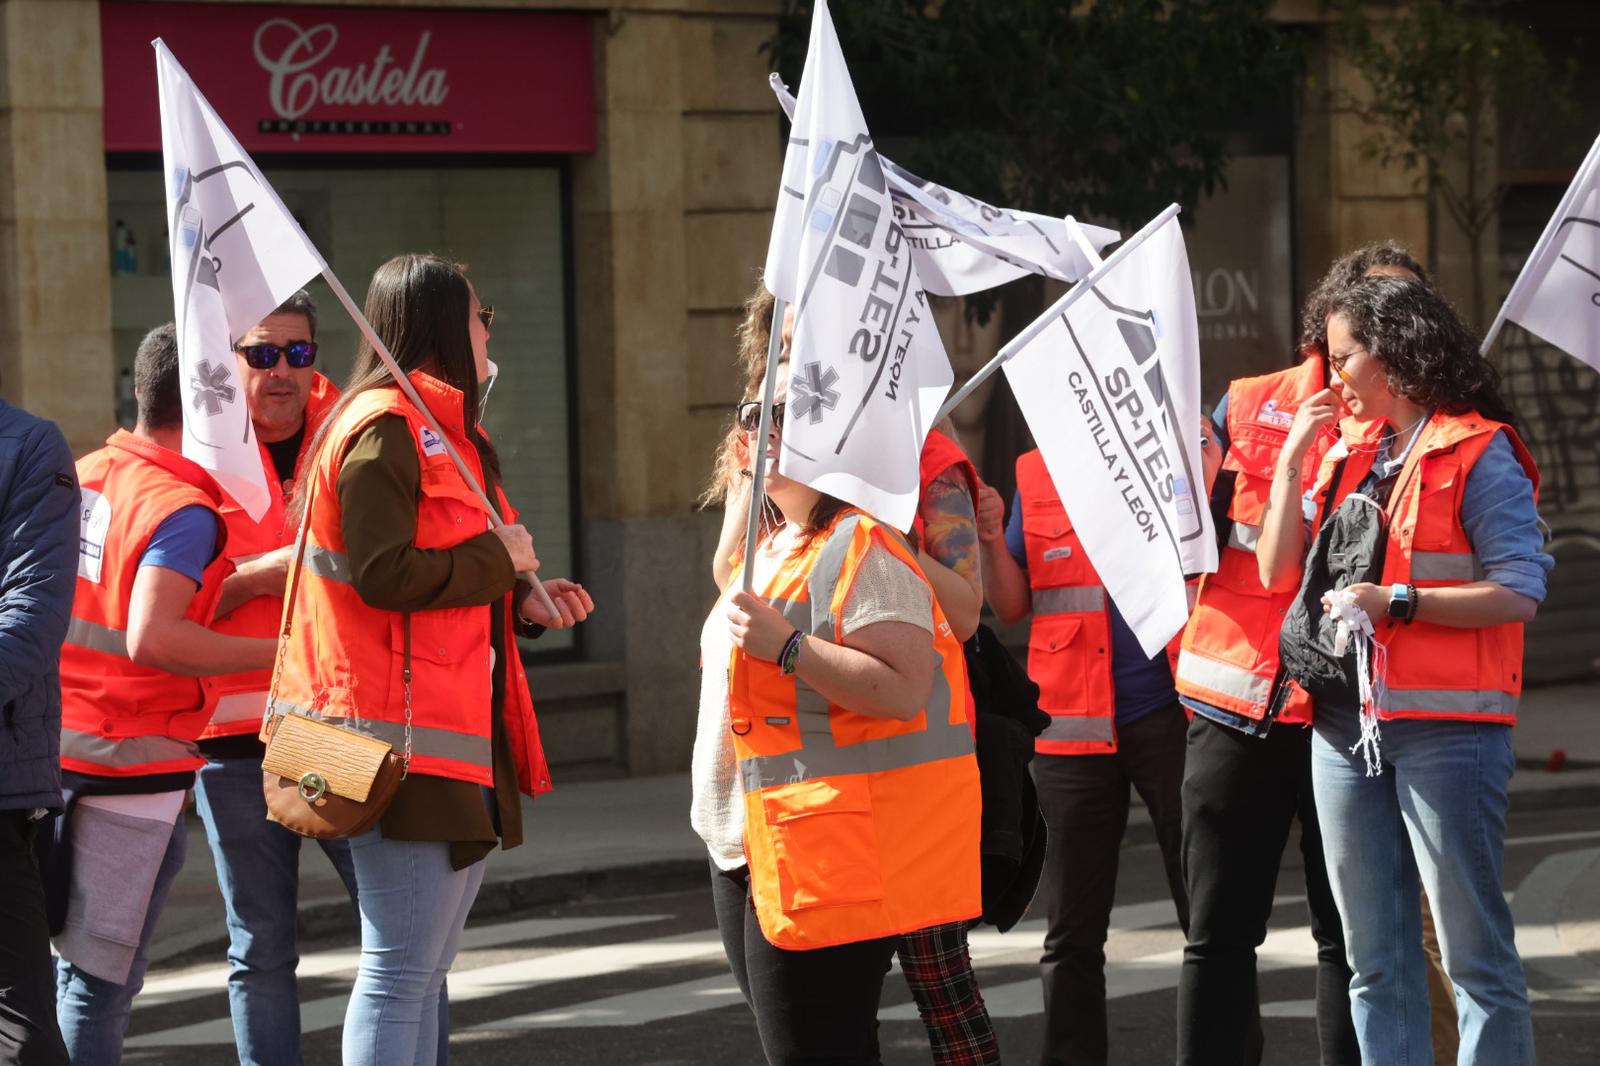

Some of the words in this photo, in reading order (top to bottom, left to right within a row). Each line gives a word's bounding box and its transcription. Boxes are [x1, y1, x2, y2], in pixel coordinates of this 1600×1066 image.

[253, 18, 449, 120] Castela
[259, 120, 450, 133] PROFESSIONAL
[906, 236, 960, 250] TILLA
[1193, 267, 1259, 317] LON
[1068, 371, 1118, 470] CASTILLA
[1105, 366, 1174, 503] SP-TES
[1114, 468, 1129, 483] Y
[1121, 484, 1159, 542] LEÓN
